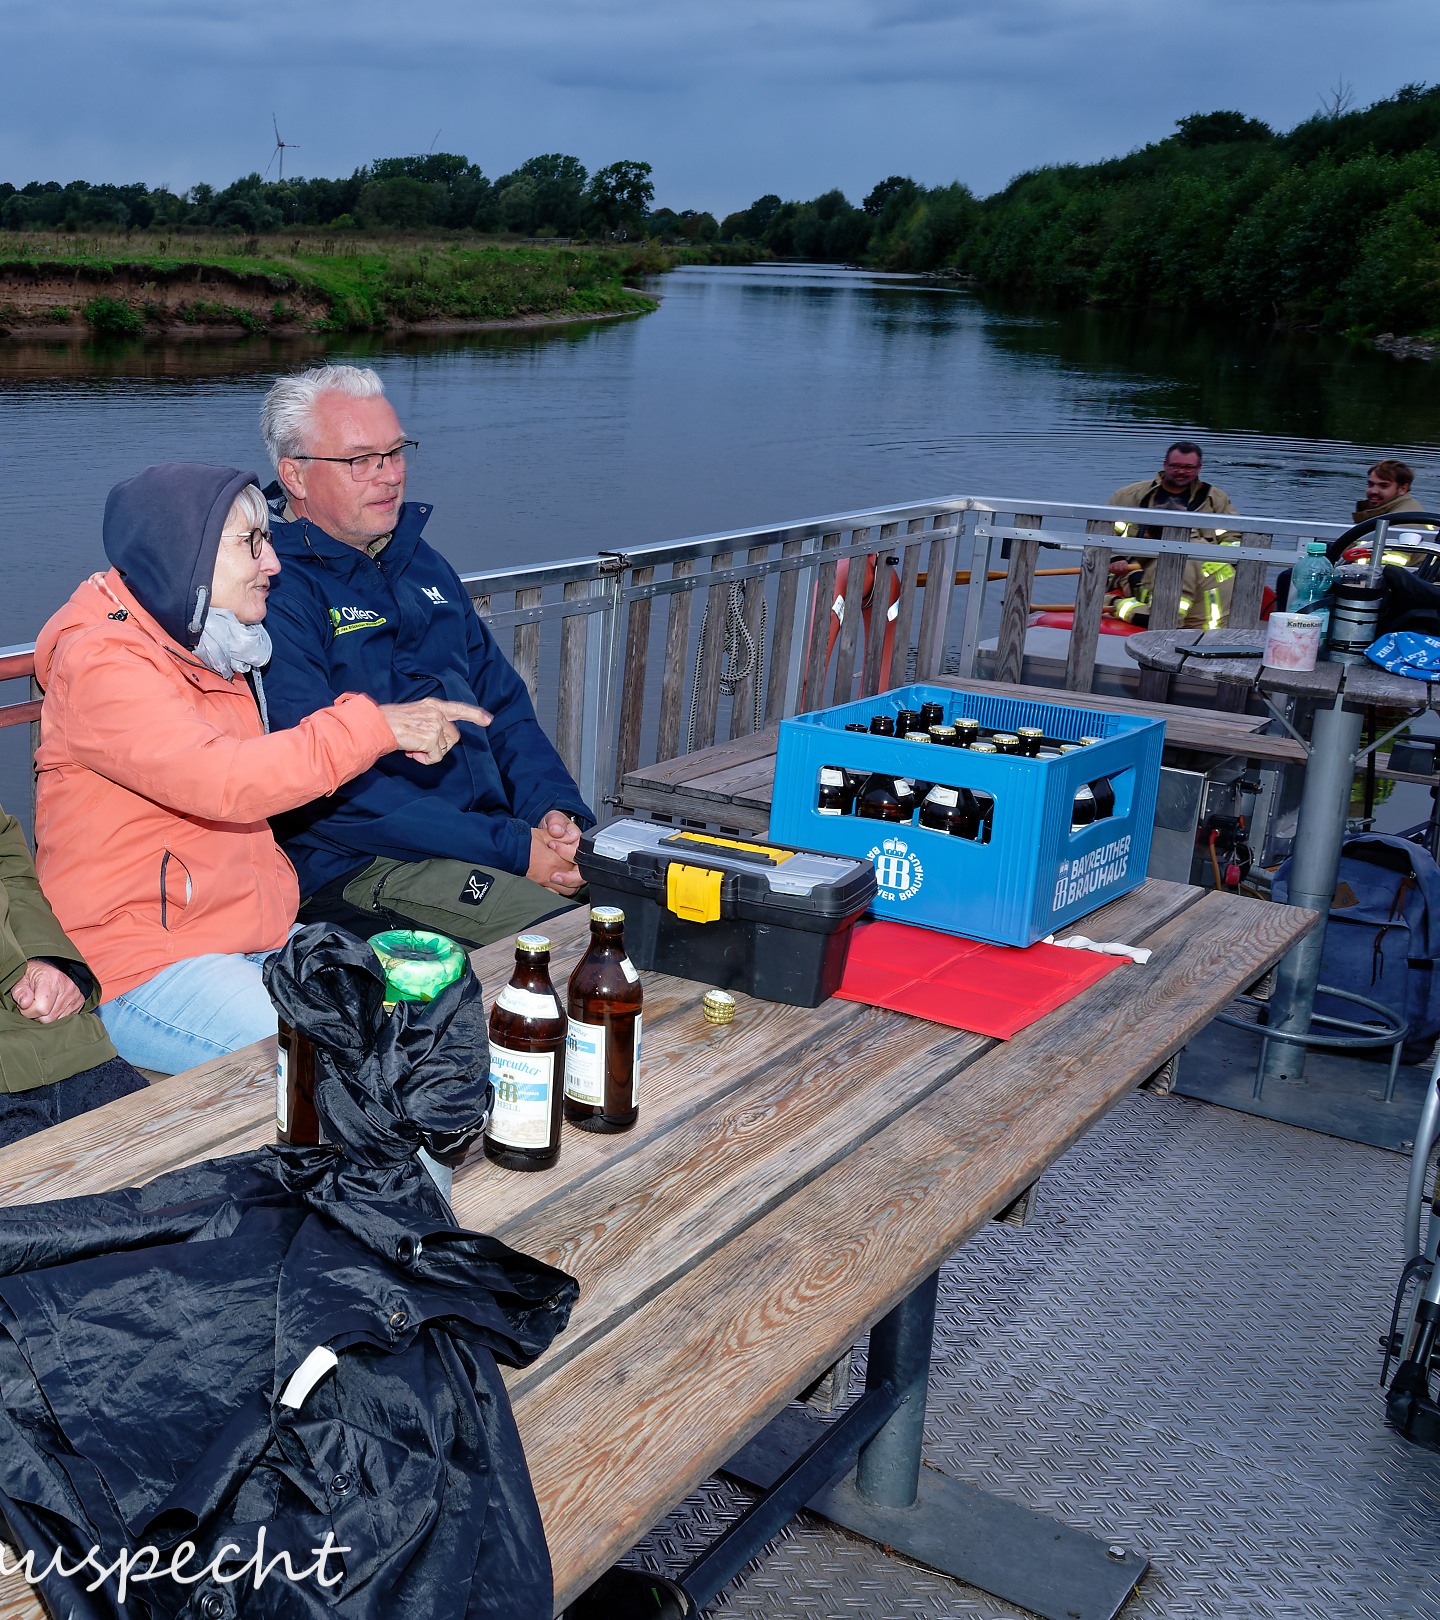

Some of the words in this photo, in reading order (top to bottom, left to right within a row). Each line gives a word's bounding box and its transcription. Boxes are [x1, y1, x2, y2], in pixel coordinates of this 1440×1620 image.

[341, 606, 380, 621] Olfen
[898, 853, 924, 901] BRAUHAUS
[1066, 854, 1129, 906] BRAUHAUS
[1071, 834, 1131, 881] BAYREUTHER
[496, 1099, 521, 1113] HELL
